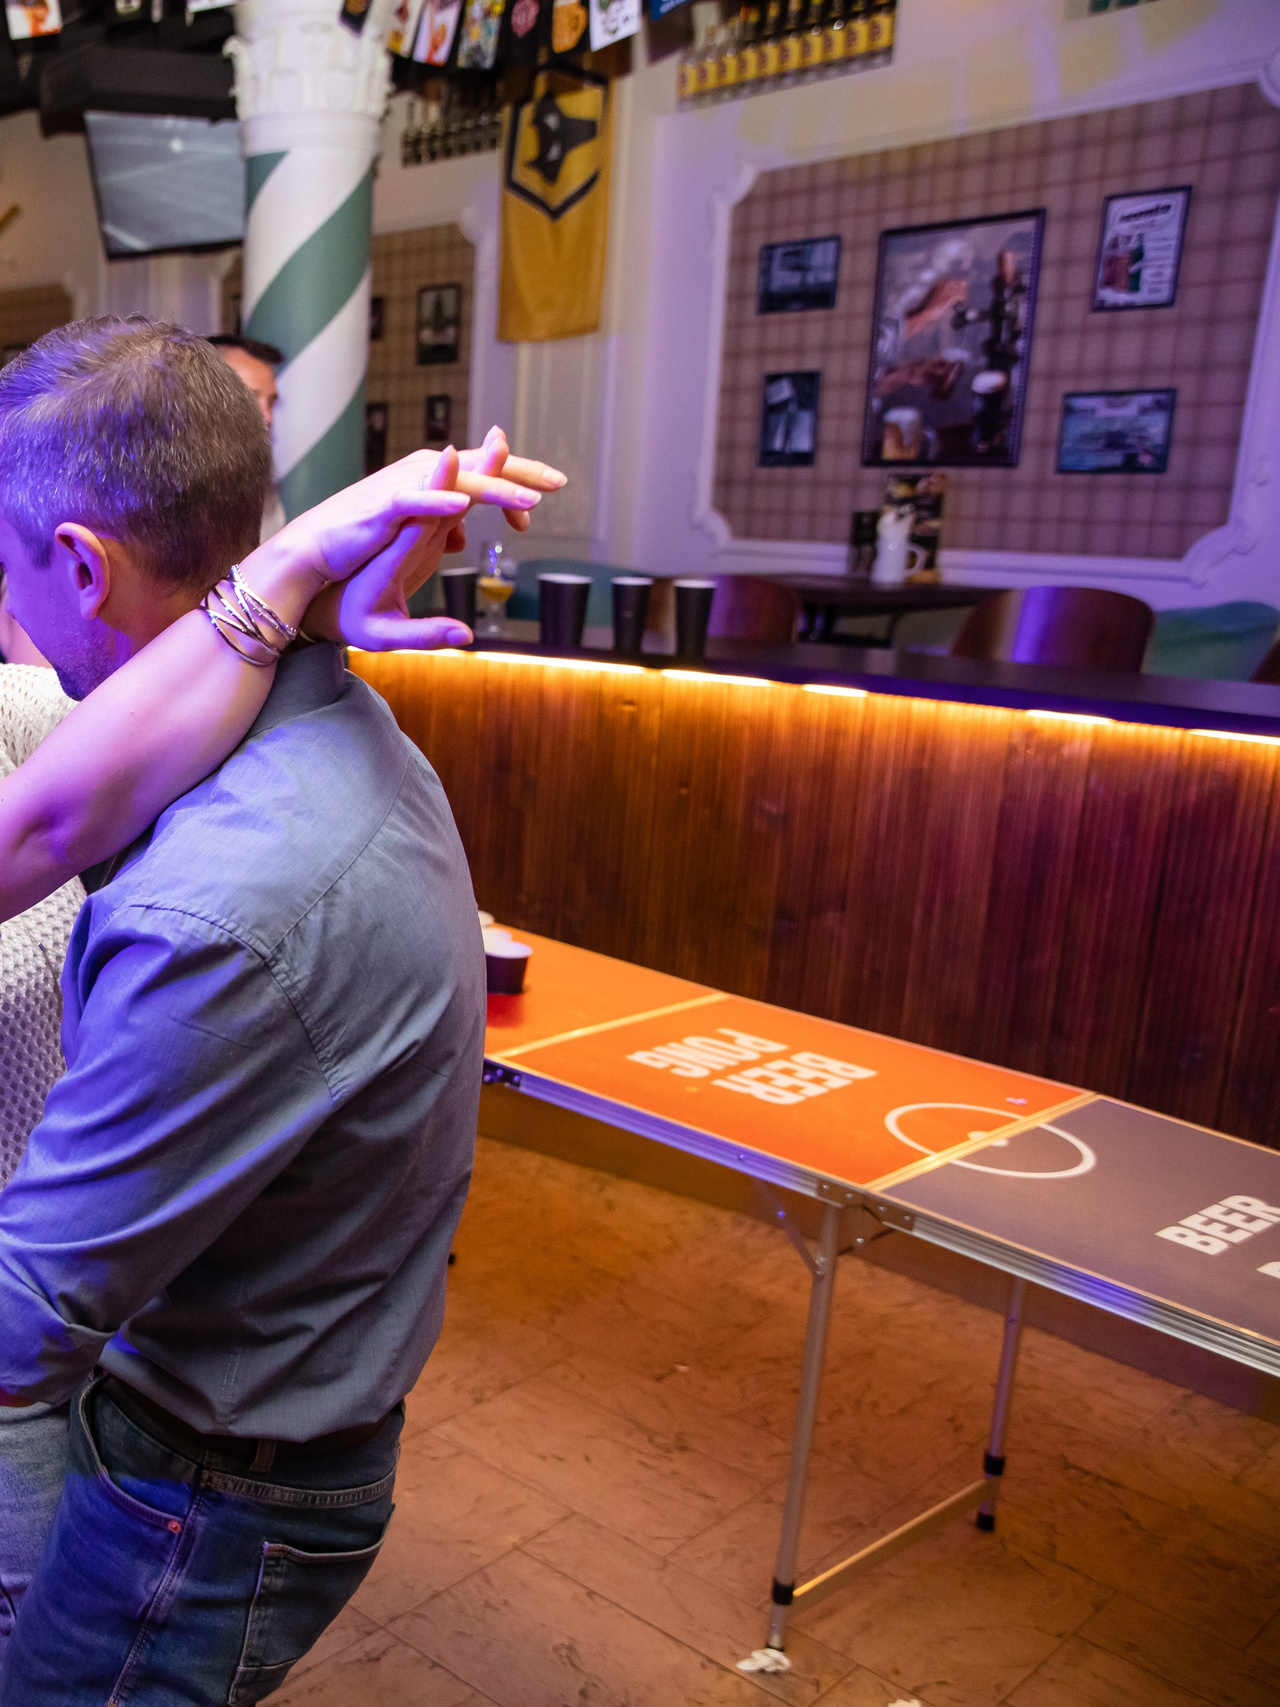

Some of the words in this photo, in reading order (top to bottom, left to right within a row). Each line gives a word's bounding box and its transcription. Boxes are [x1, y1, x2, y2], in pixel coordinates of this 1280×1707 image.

[625, 1027, 790, 1079] PONG
[710, 1051, 878, 1105] BEER
[1153, 1194, 1280, 1256] BEER
